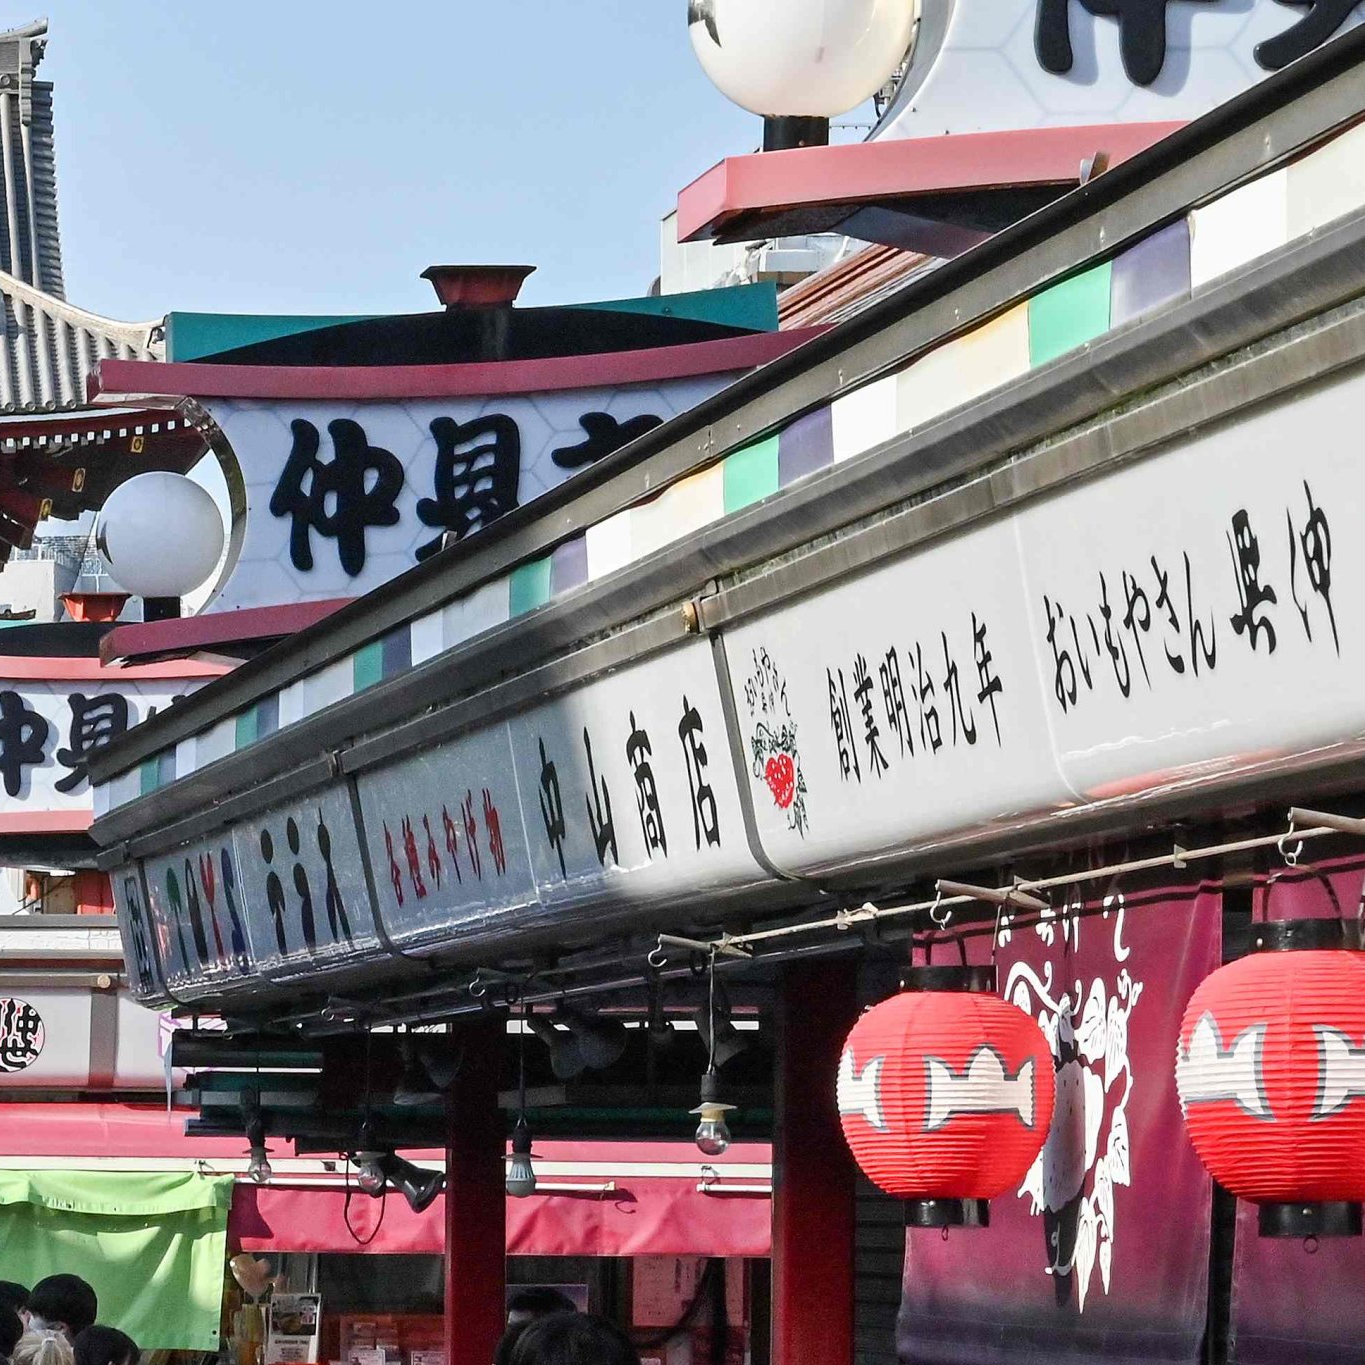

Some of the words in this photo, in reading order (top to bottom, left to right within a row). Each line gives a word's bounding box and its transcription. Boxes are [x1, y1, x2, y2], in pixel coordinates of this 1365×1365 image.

[826, 612, 1002, 784] 創業明治九年
[1043, 551, 1216, 714] おいもやさん
[539, 695, 722, 878] 中山商店
